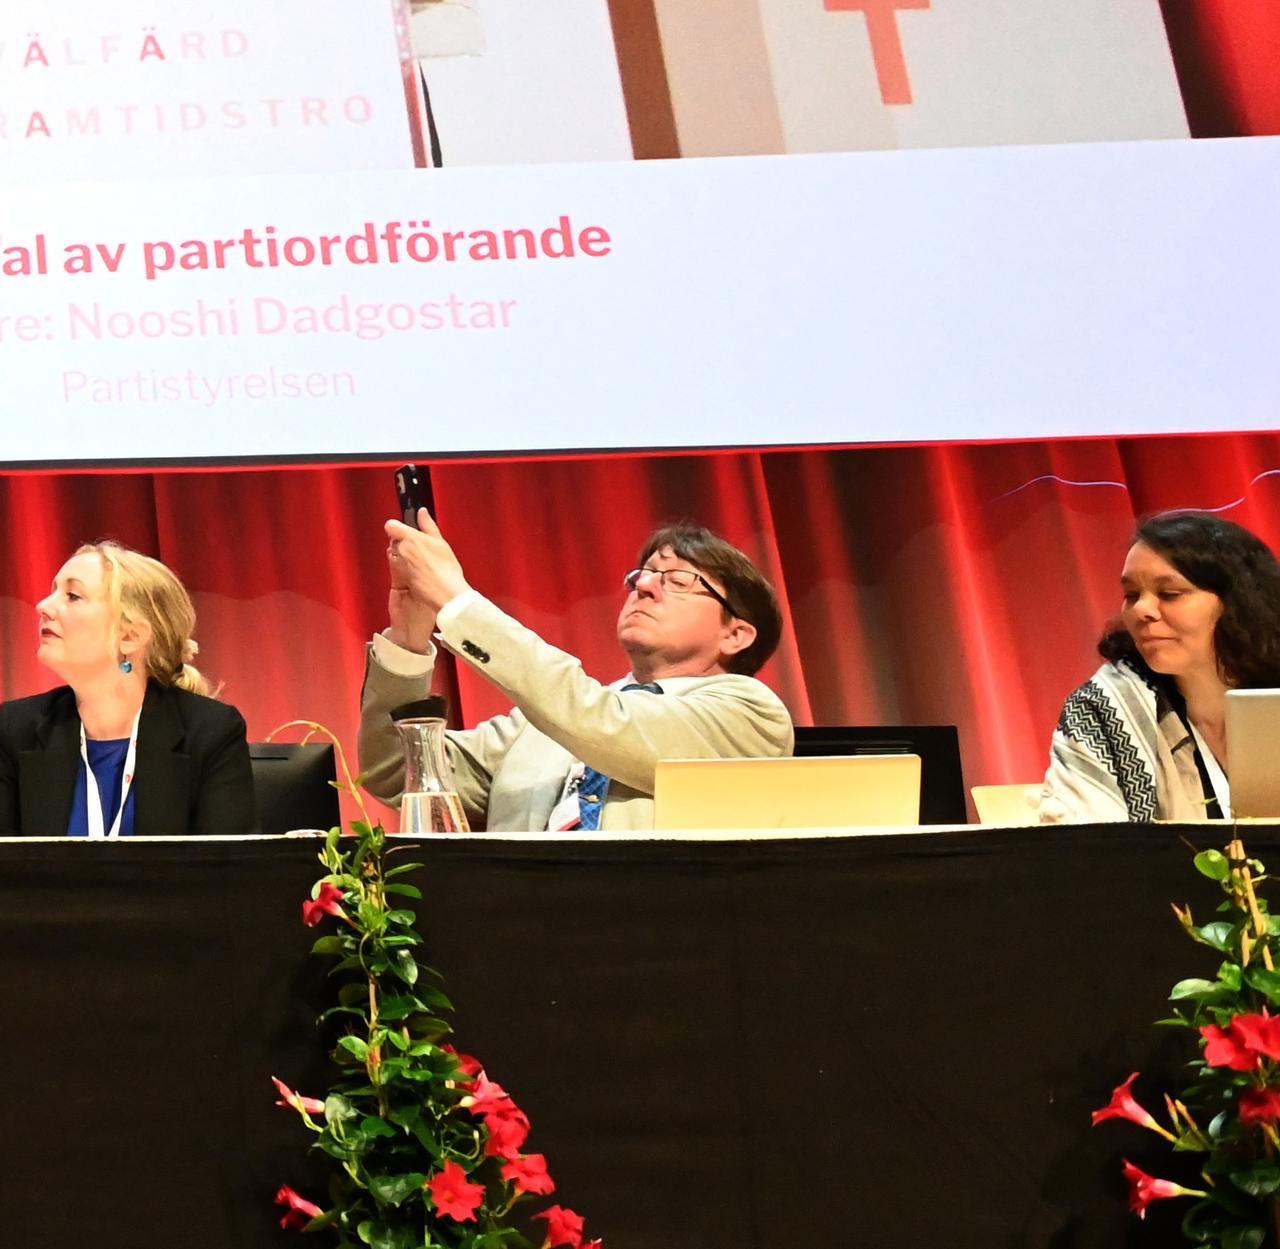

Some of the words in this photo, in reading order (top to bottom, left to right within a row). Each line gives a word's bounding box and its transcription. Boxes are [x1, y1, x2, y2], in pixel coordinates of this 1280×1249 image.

[62, 241, 127, 277] av
[142, 213, 614, 282] partiordförande
[67, 297, 240, 341] Nooshi
[252, 290, 520, 342] Dadgostar
[61, 364, 358, 407] Partistyrelsen
